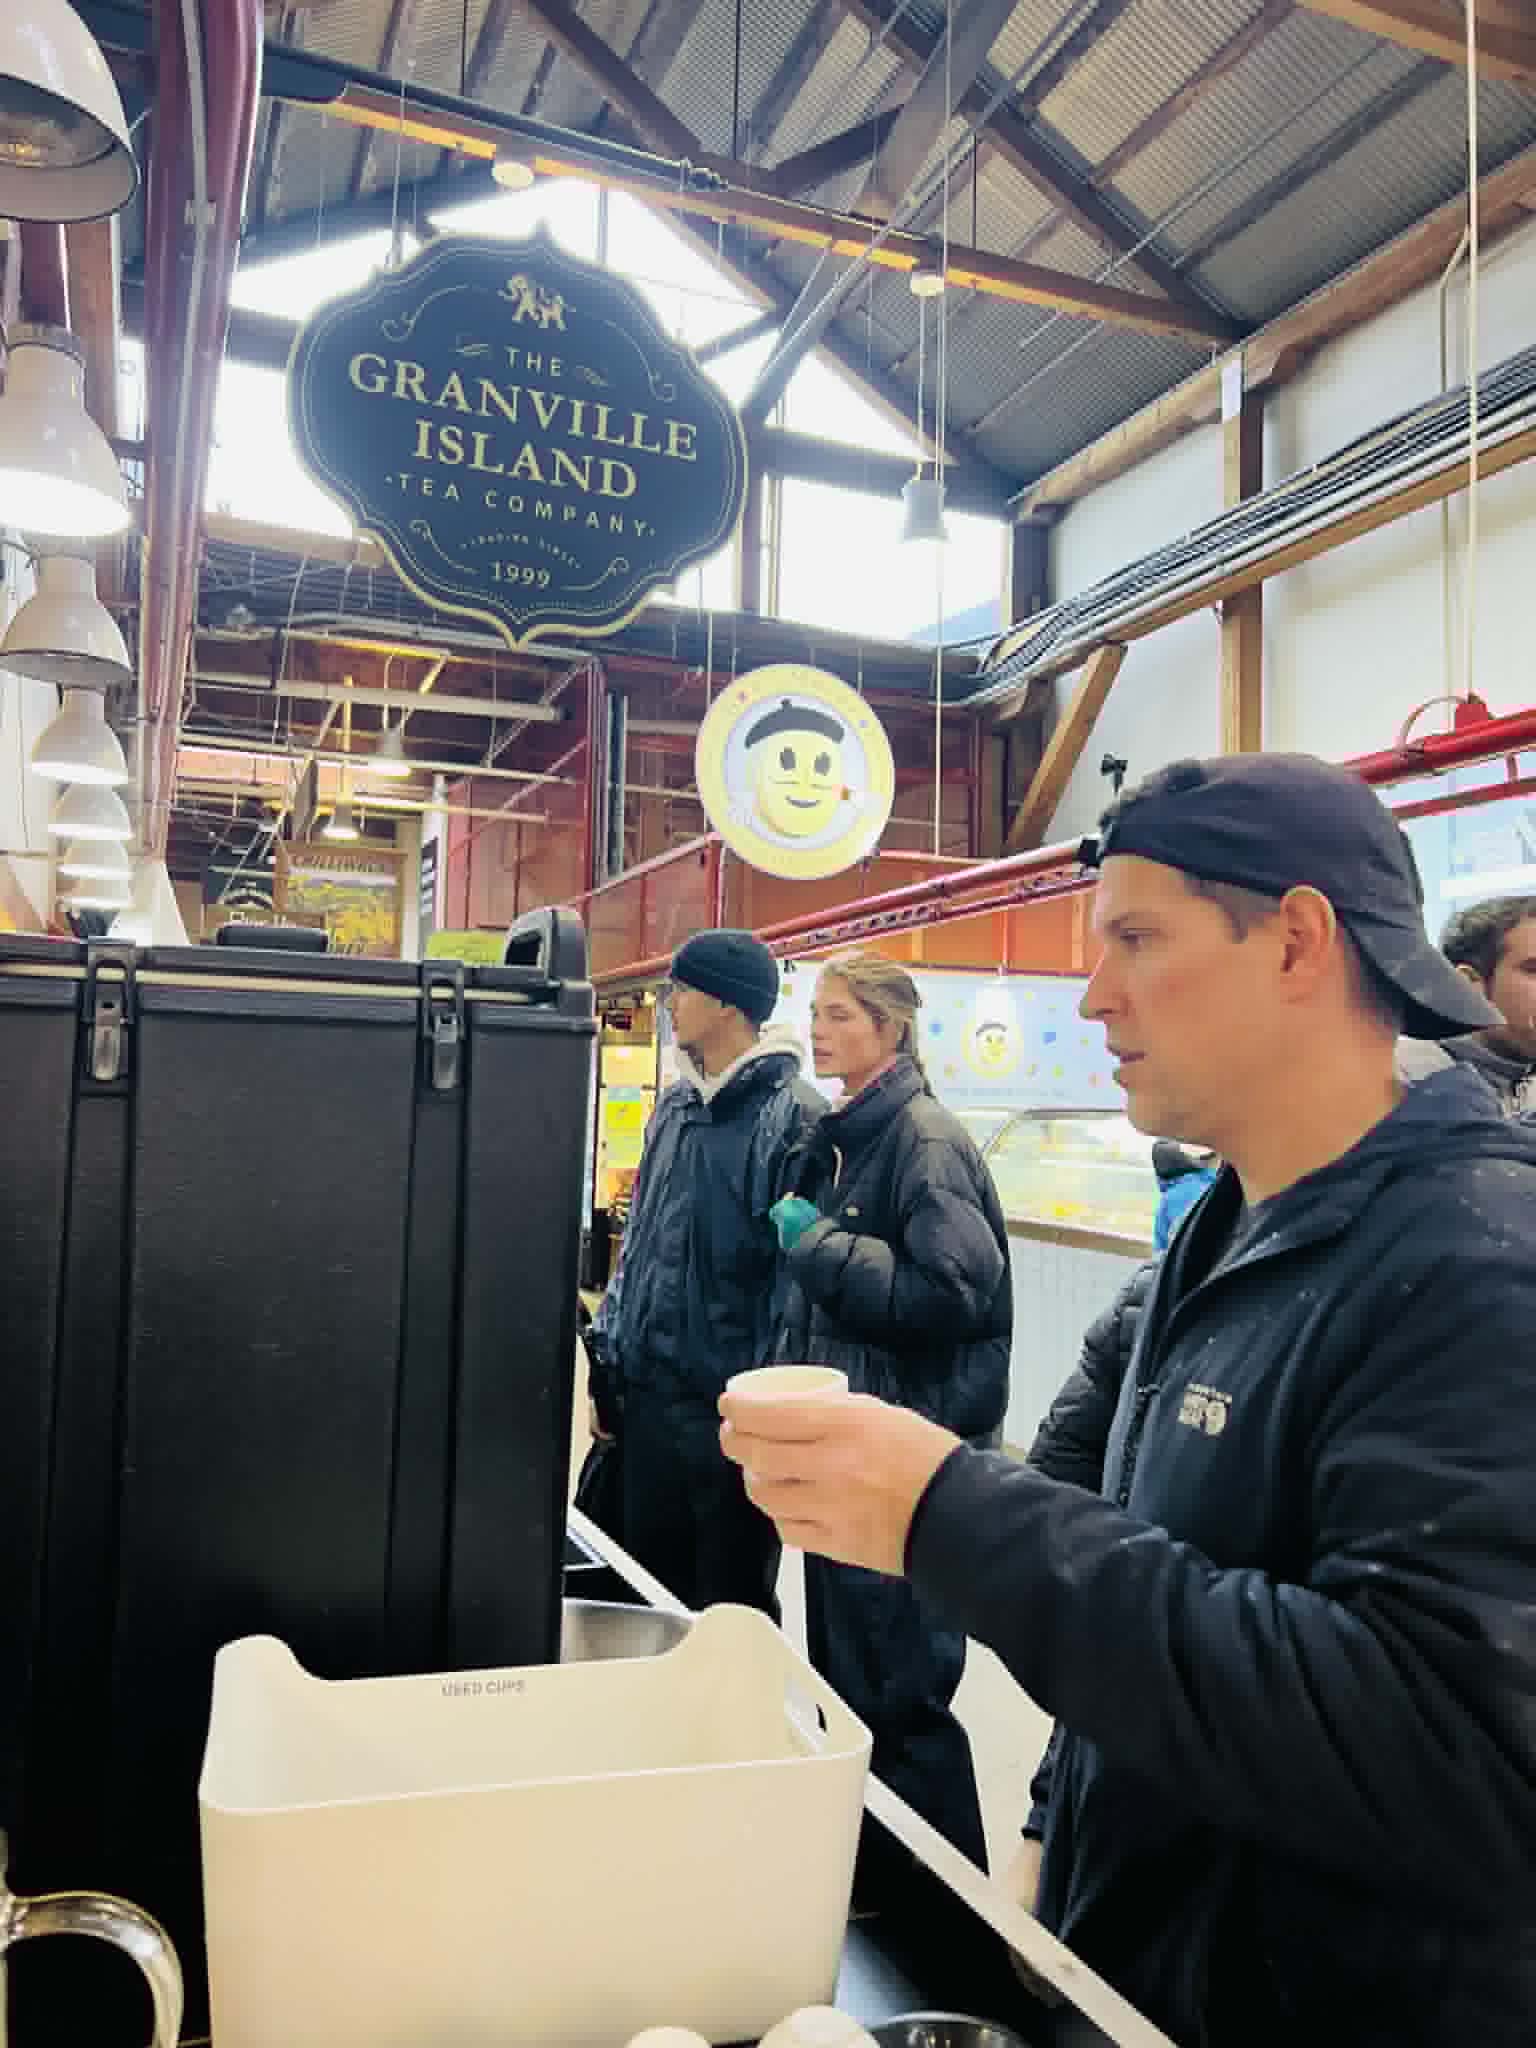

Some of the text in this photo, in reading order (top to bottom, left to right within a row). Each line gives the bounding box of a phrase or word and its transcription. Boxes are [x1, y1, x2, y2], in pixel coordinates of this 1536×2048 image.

[504, 344, 562, 377] THE
[349, 351, 697, 462] GRANVILLE
[411, 417, 638, 498] ISLAND
[399, 472, 648, 537] TEA COMPANY
[489, 560, 551, 590] 1999
